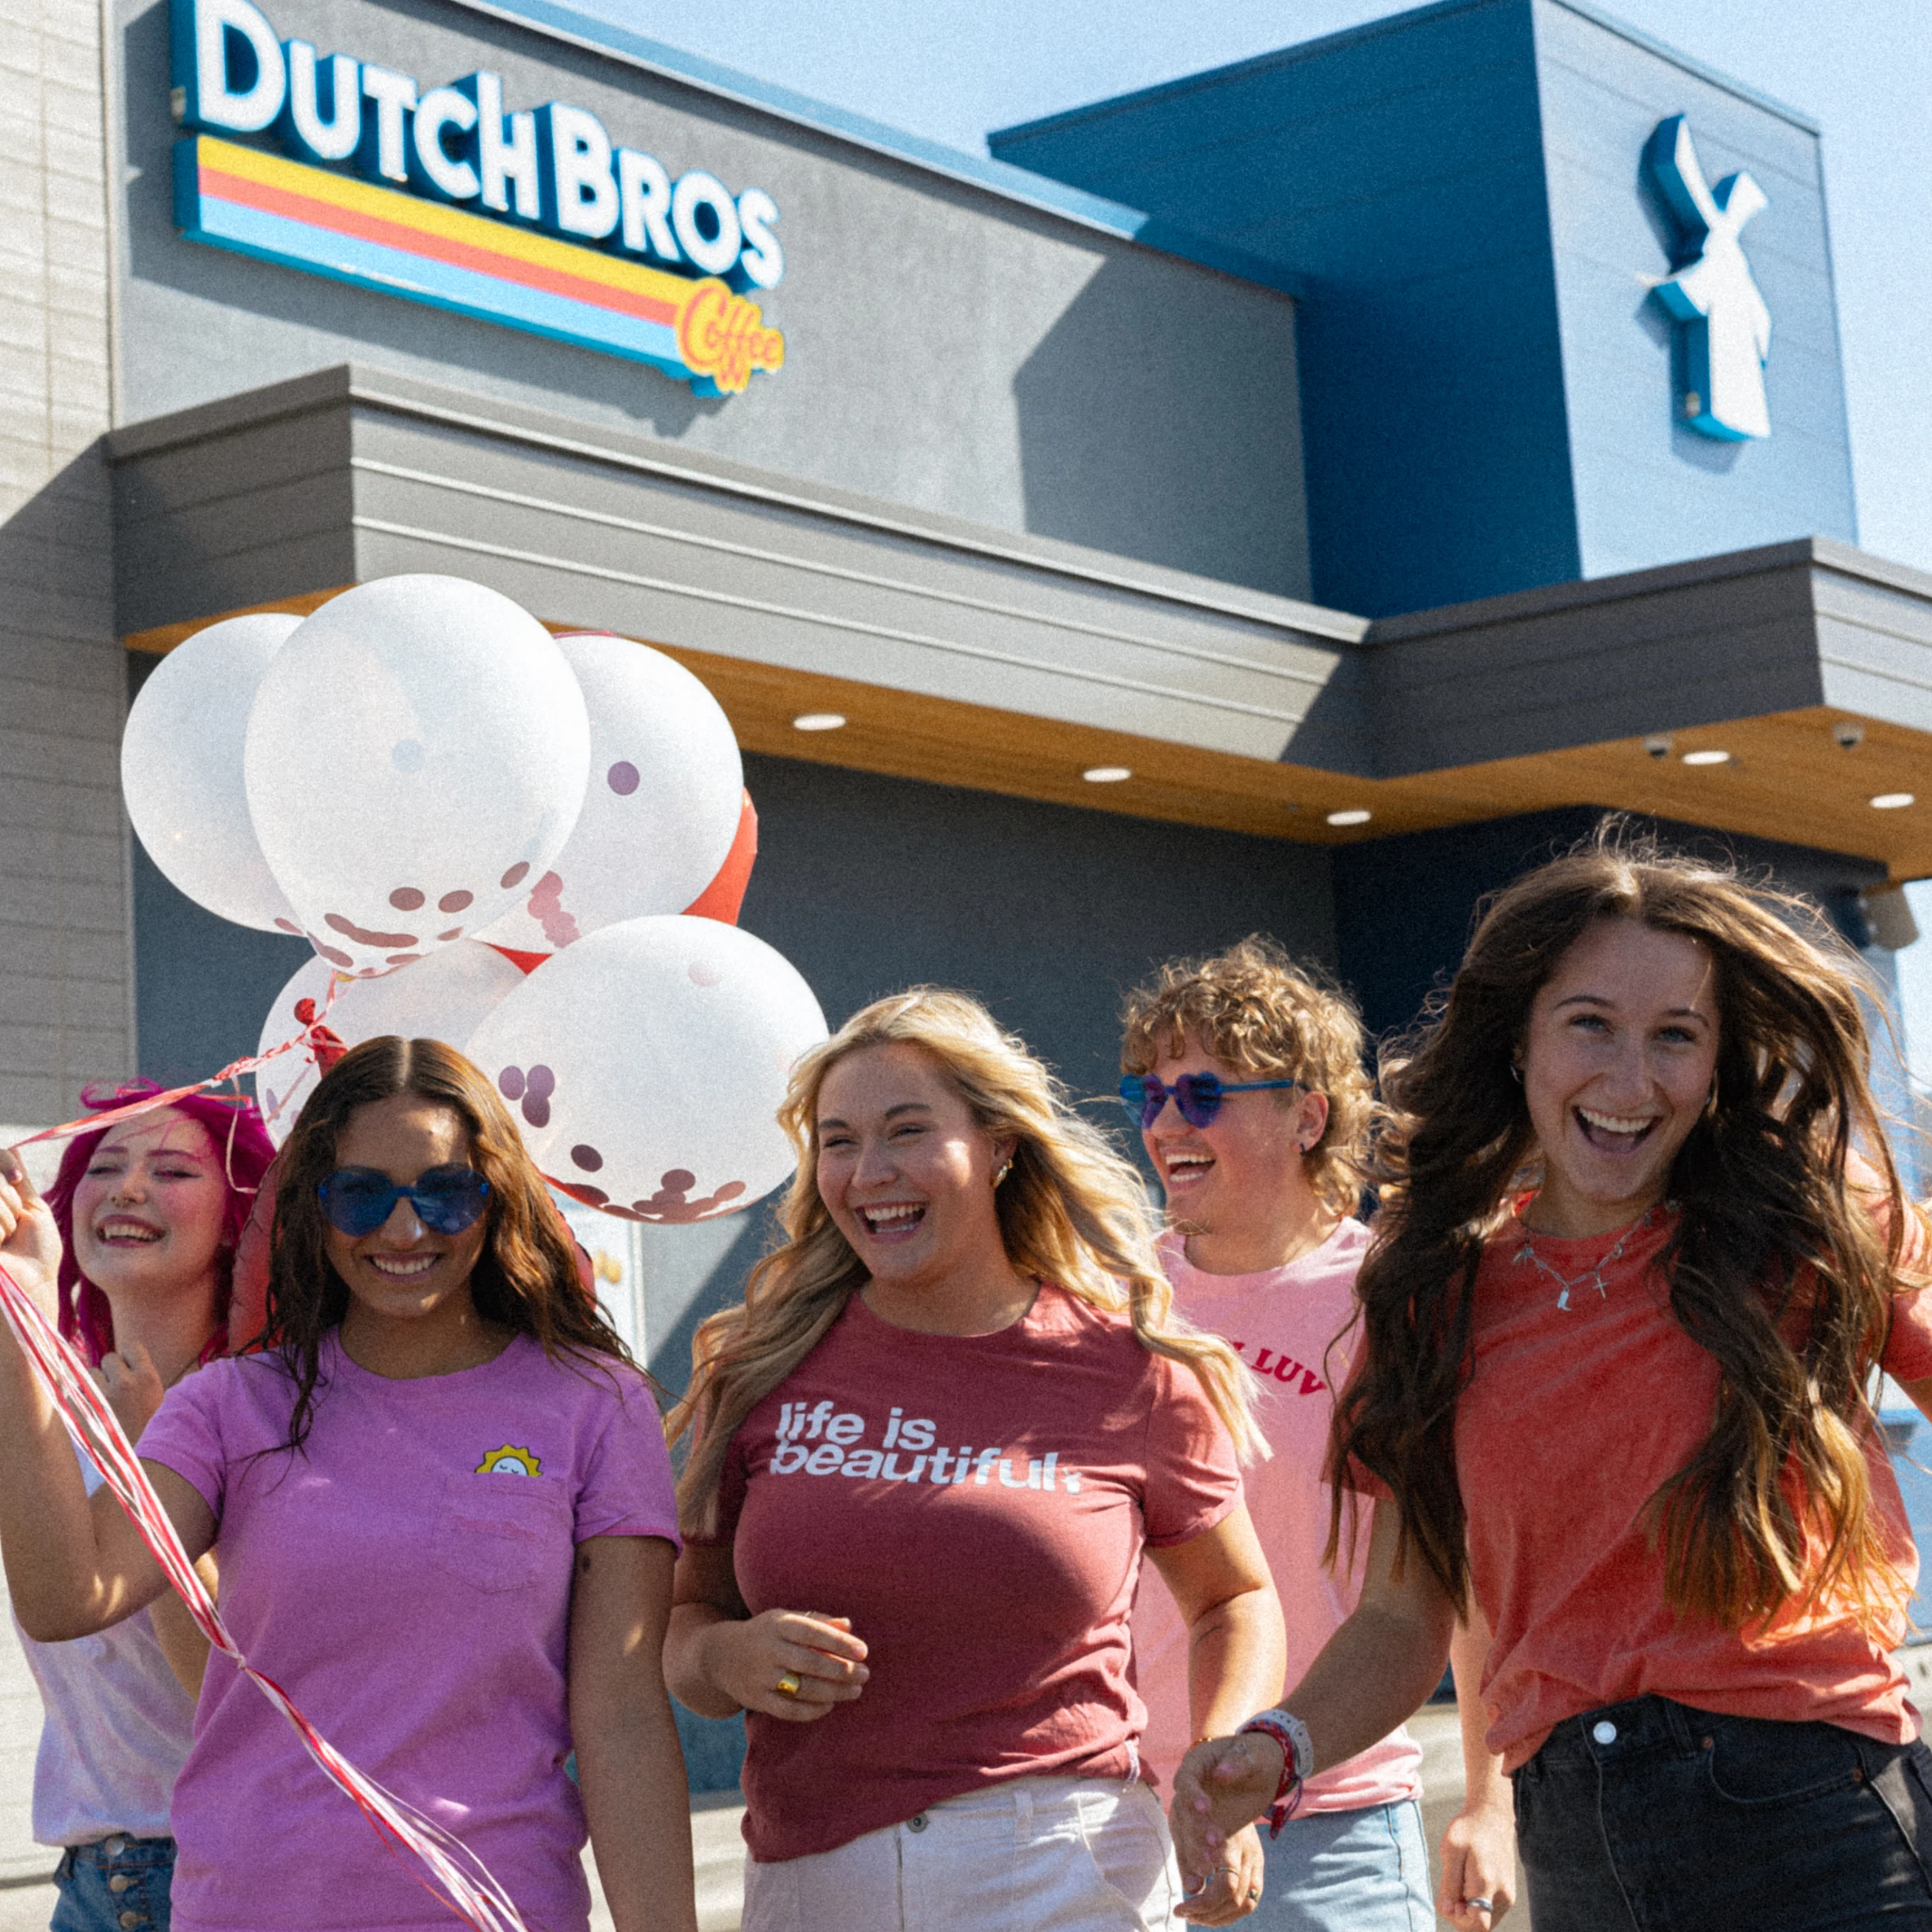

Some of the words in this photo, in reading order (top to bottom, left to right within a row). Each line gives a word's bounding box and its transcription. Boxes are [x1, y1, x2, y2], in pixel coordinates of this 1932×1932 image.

[679, 284, 782, 386] Coffee
[1251, 1348, 1328, 1396] LUV
[775, 1401, 864, 1445] life
[883, 1407, 937, 1450] is
